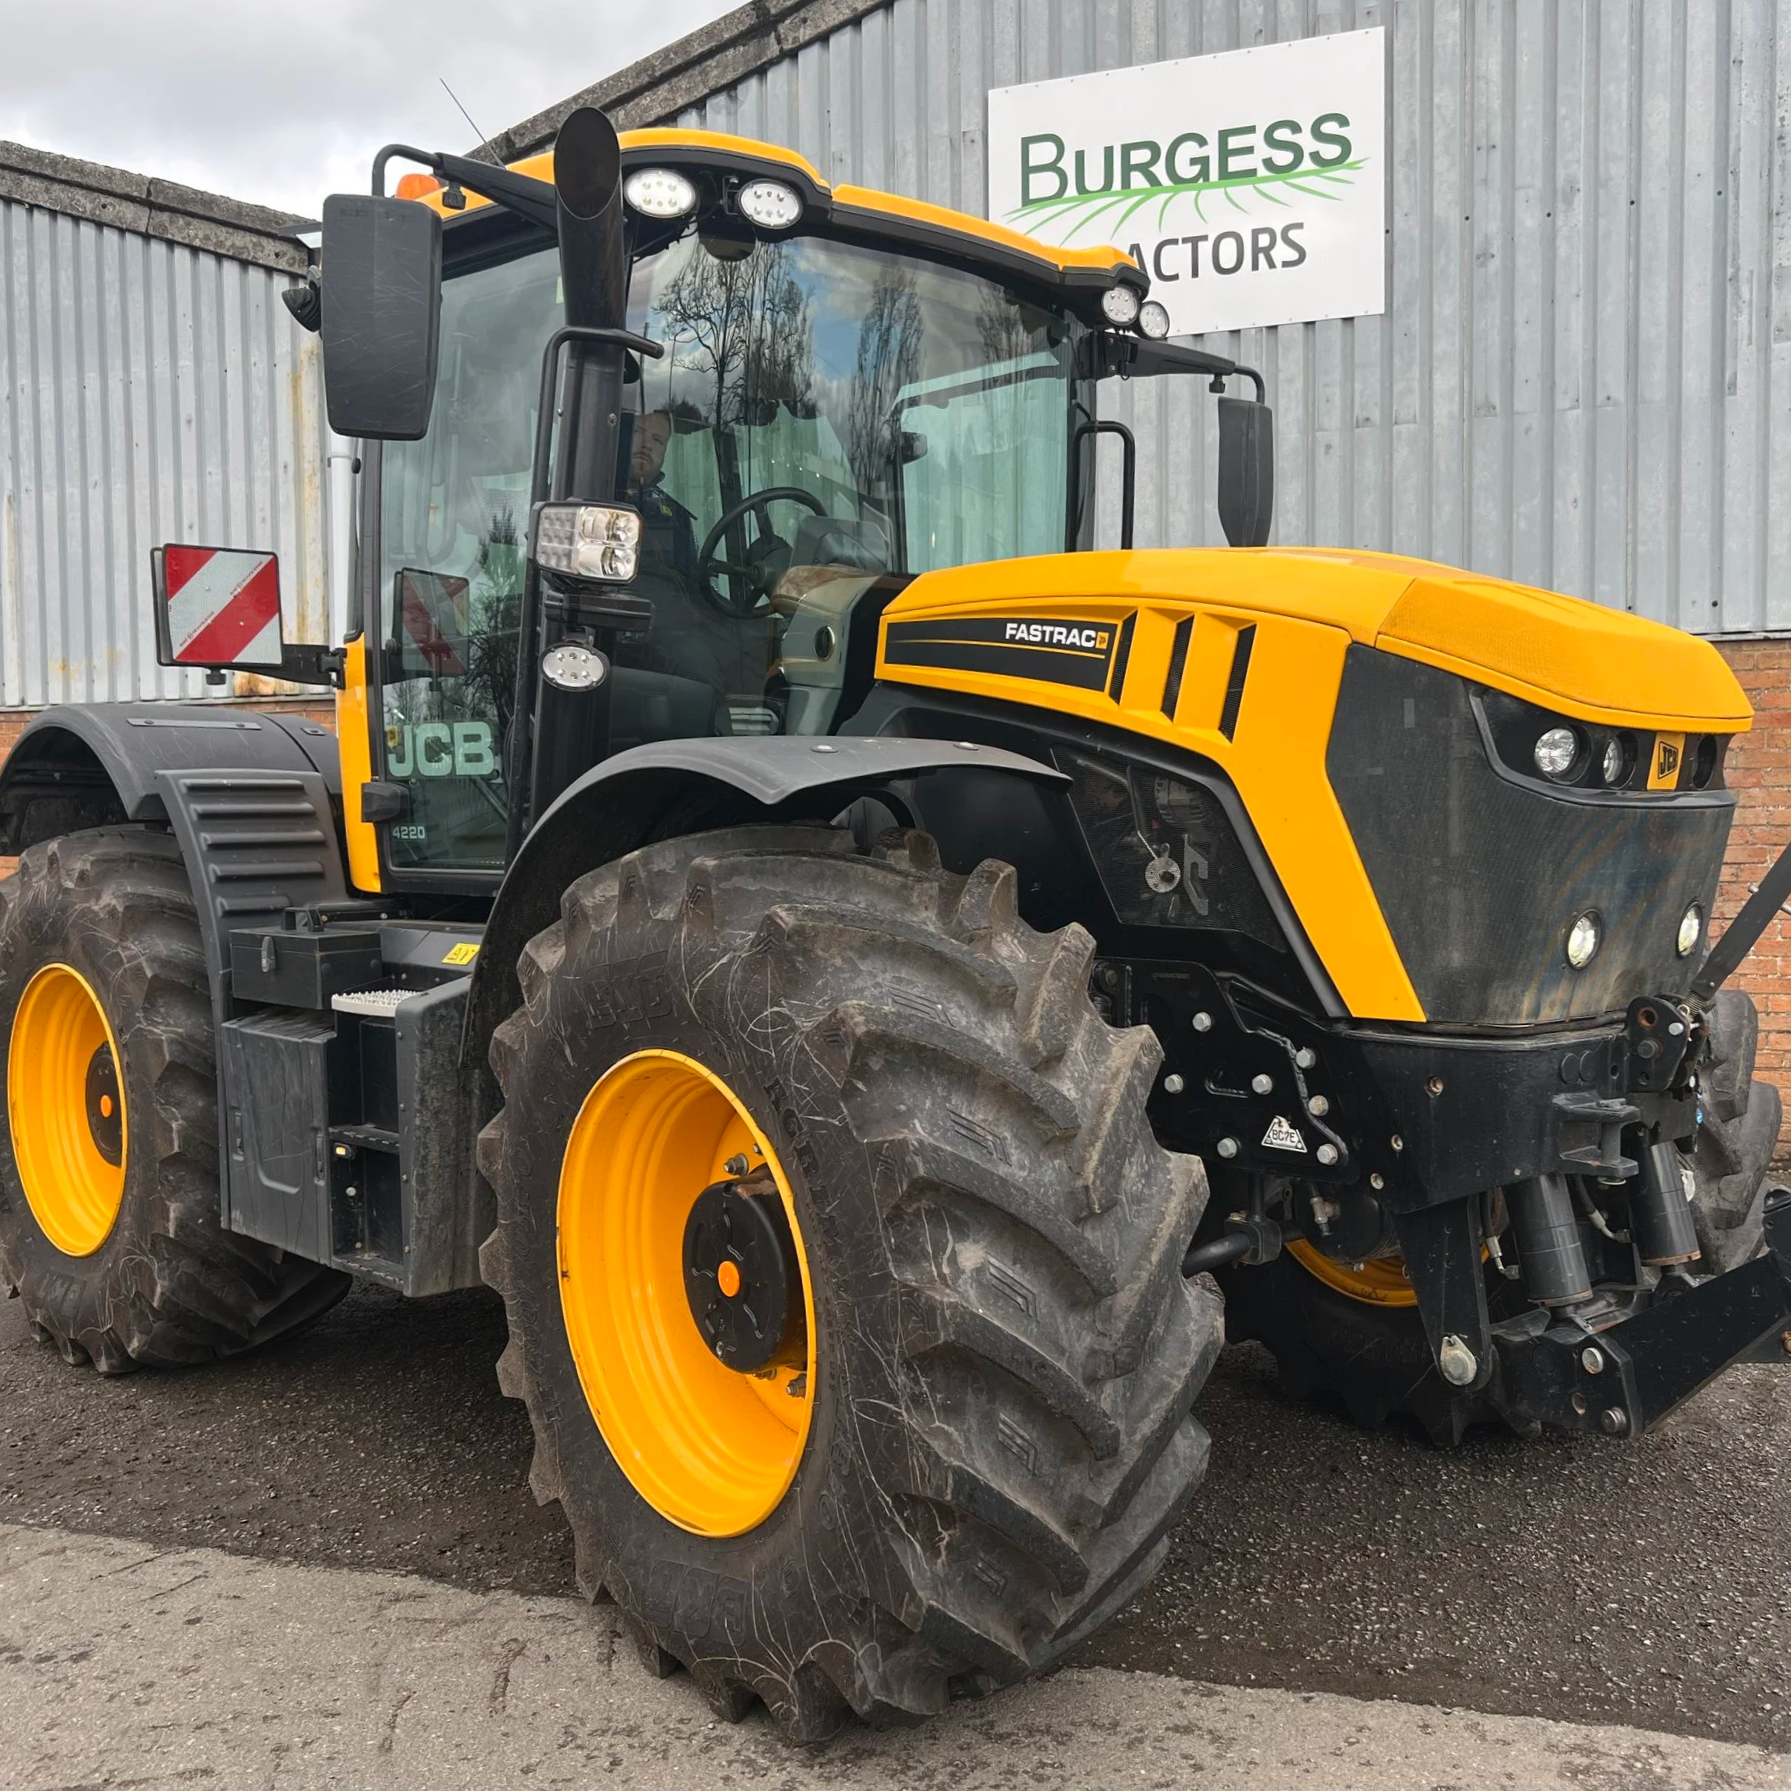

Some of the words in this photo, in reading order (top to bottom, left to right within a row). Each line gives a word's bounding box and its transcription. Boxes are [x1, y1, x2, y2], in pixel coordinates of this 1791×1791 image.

[1021, 113, 1352, 207] BURGESS
[1005, 622, 1096, 647] FASTRAC
[388, 721, 495, 777] JCB
[392, 825, 426, 839] 4220
